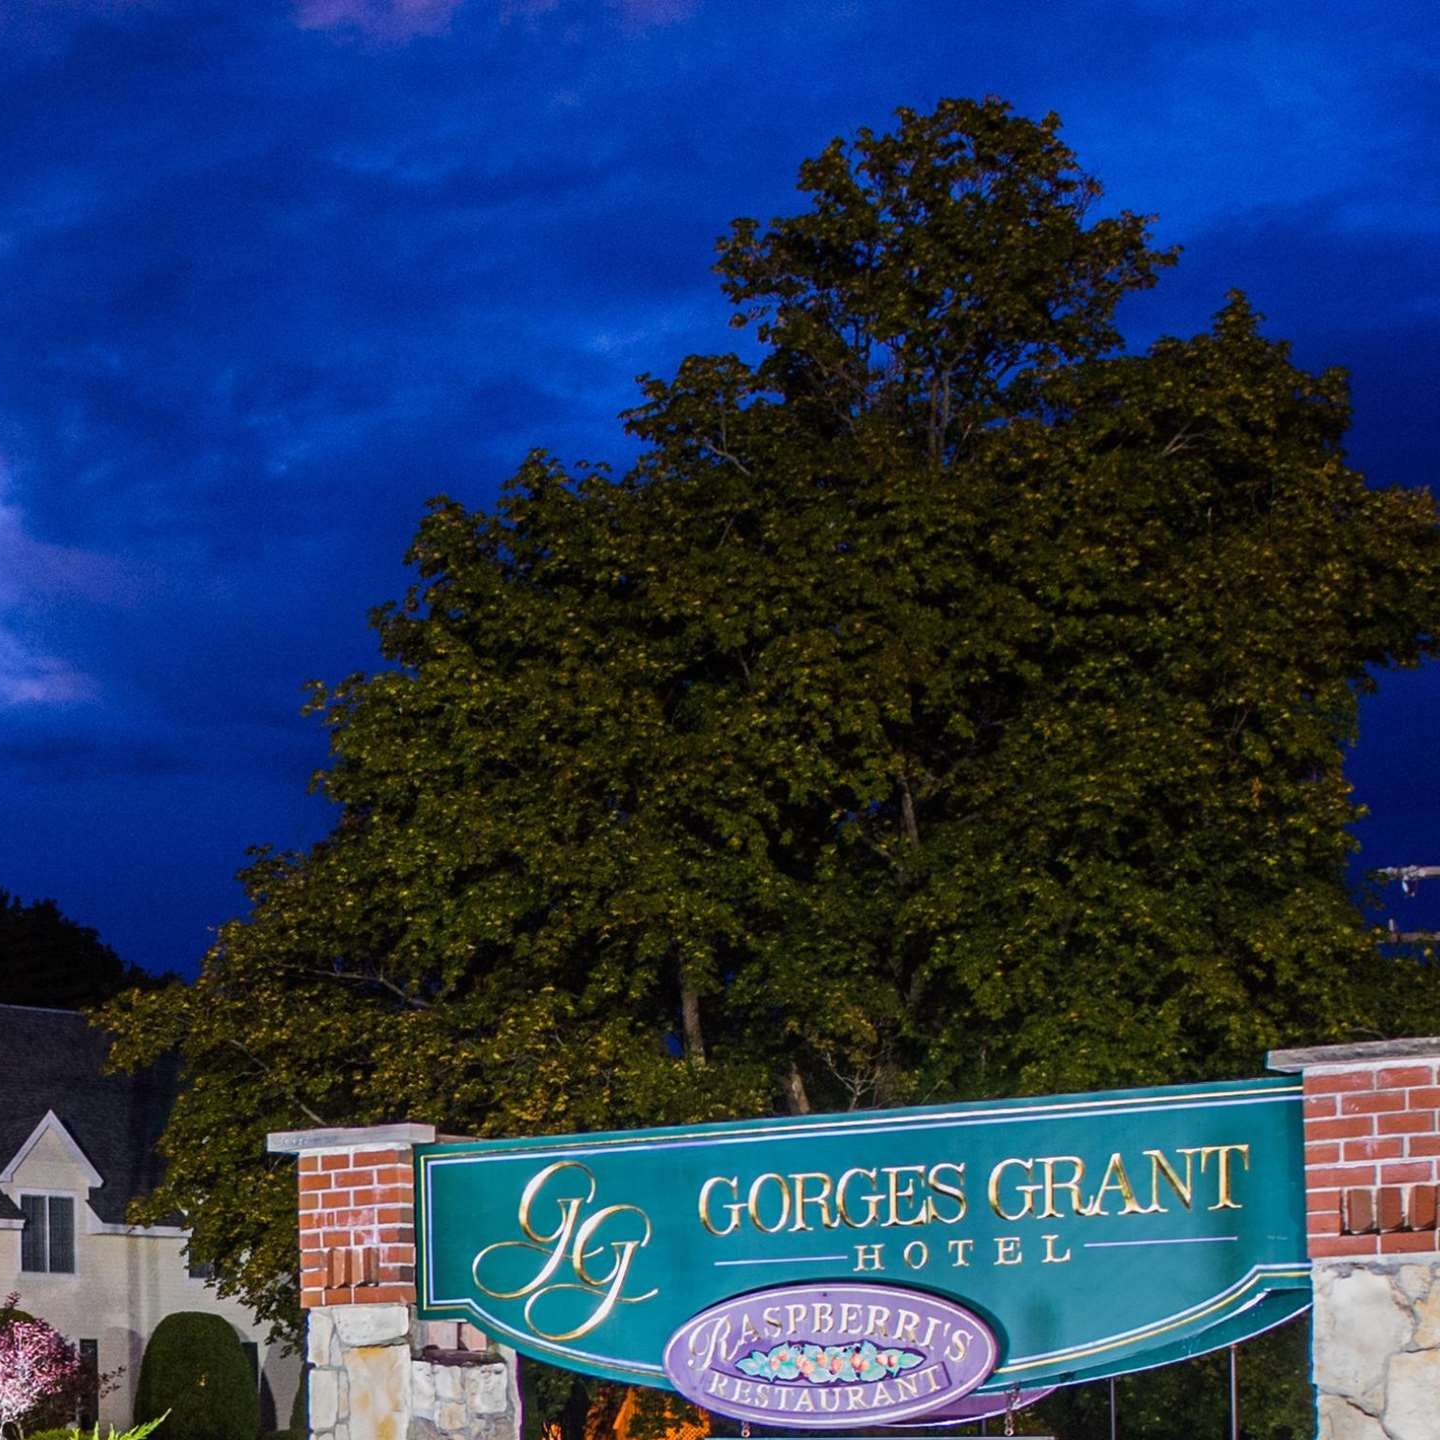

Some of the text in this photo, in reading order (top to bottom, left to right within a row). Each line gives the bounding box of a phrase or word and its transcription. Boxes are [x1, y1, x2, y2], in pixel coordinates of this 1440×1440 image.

[698, 1144, 1250, 1236] GORGES GRANT
[853, 1235, 1071, 1271] HOTEL
[687, 1303, 973, 1372] RASPBERRI'S
[709, 1364, 942, 1412] RESTAURANT
